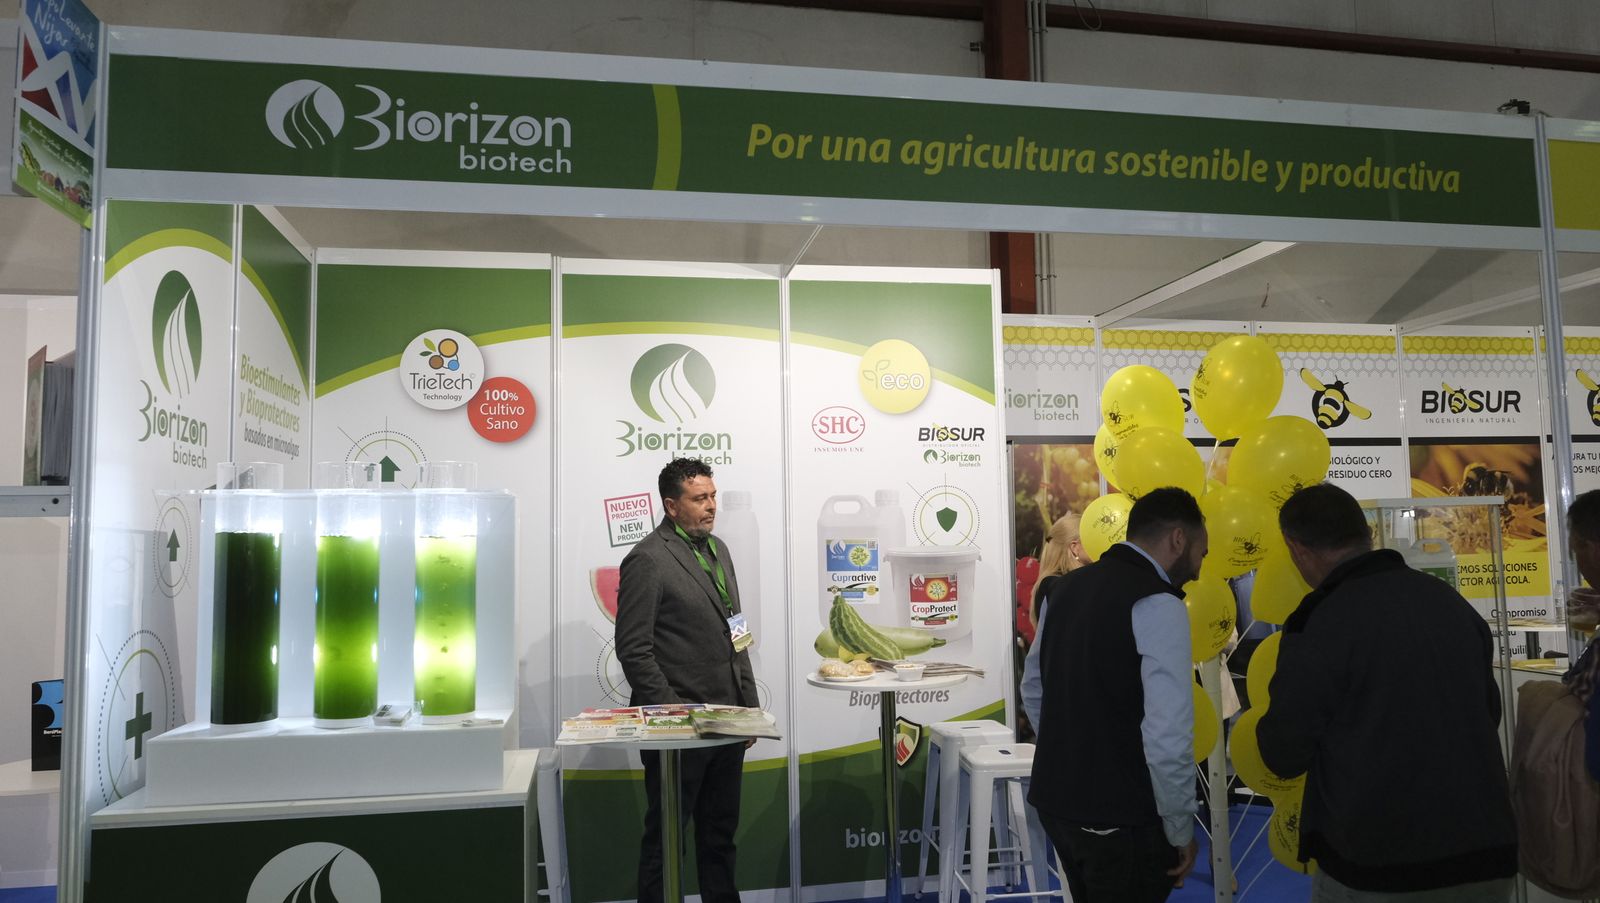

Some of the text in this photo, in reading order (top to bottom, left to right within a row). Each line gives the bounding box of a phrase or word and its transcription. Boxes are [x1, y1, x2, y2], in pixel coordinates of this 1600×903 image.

[353, 84, 572, 150] Biorizon
[460, 145, 572, 174] biotech
[747, 123, 1460, 193] Por una agricultura sostenible y productiva
[240, 353, 301, 406] Bioestimulantes
[409, 373, 473, 390] TrieTech
[880, 373, 924, 390] eco
[423, 393, 463, 402] Technology
[484, 389, 519, 401] 100%
[1004, 388, 1078, 409] iorizon
[1421, 388, 1521, 414] BIOSUR
[137, 379, 208, 447] Biorizon
[239, 388, 300, 433] y Bioprotectores
[480, 403, 525, 416] Cultivo
[1034, 409, 1079, 421] biotech
[486, 417, 518, 430] Sano
[818, 415, 860, 434] SHC
[244, 422, 300, 460] basados en microalgas
[615, 419, 732, 457] Biorizon
[918, 427, 985, 442] BIOSUR
[173, 441, 207, 469] biotech
[940, 449, 981, 464] Biorizon
[1375, 456, 1381, 465] Y
[1328, 469, 1392, 479] RESIDUO CERO
[610, 498, 647, 513] NUEVO
[611, 509, 649, 520] PRODUCTO
[619, 521, 644, 533] NEW
[831, 573, 877, 583] Cupractive
[912, 604, 957, 615] CropProtect
[849, 689, 950, 711] Bioptectores
